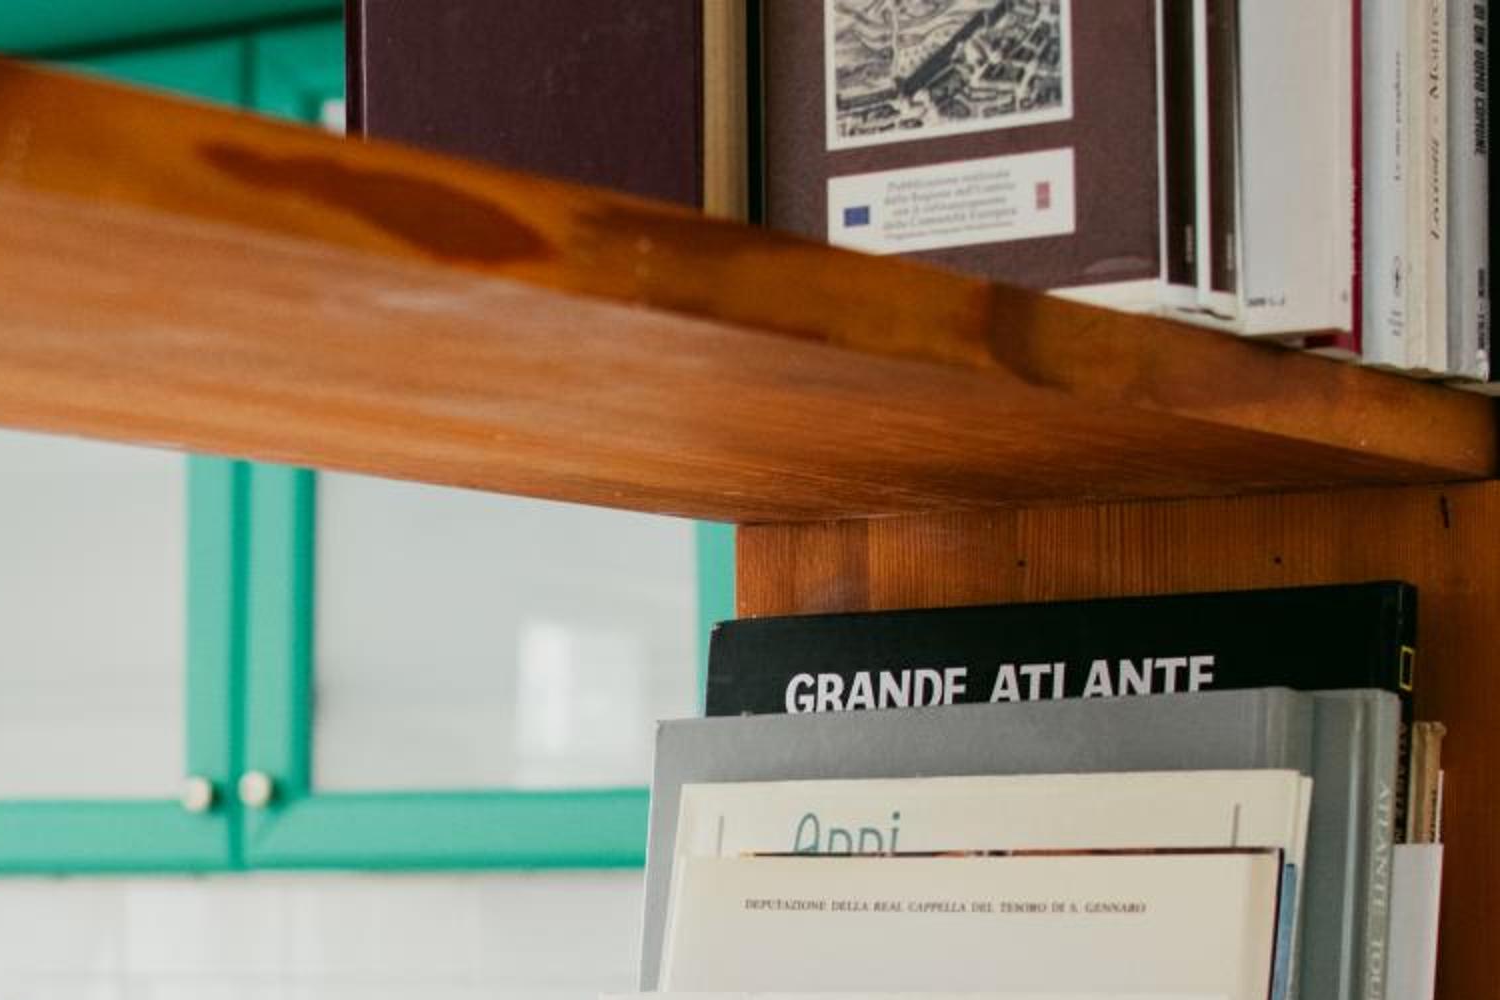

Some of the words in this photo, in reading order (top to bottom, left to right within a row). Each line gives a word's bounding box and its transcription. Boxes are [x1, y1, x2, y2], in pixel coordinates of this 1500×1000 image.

[785, 667, 967, 713] GRANDE
[990, 656, 1215, 702] ATLANTE
[1371, 780, 1392, 907] ATLANTE
[744, 899, 826, 911] DEPUTAZIONE
[831, 900, 868, 912] DELLA
[873, 900, 901, 912] REAL
[907, 901, 966, 913] CAPPELLA
[971, 901, 994, 913] DEL
[999, 902, 1046, 914] TESORO
[1051, 902, 1065, 914] DI
[1085, 902, 1148, 914] GENNARO
